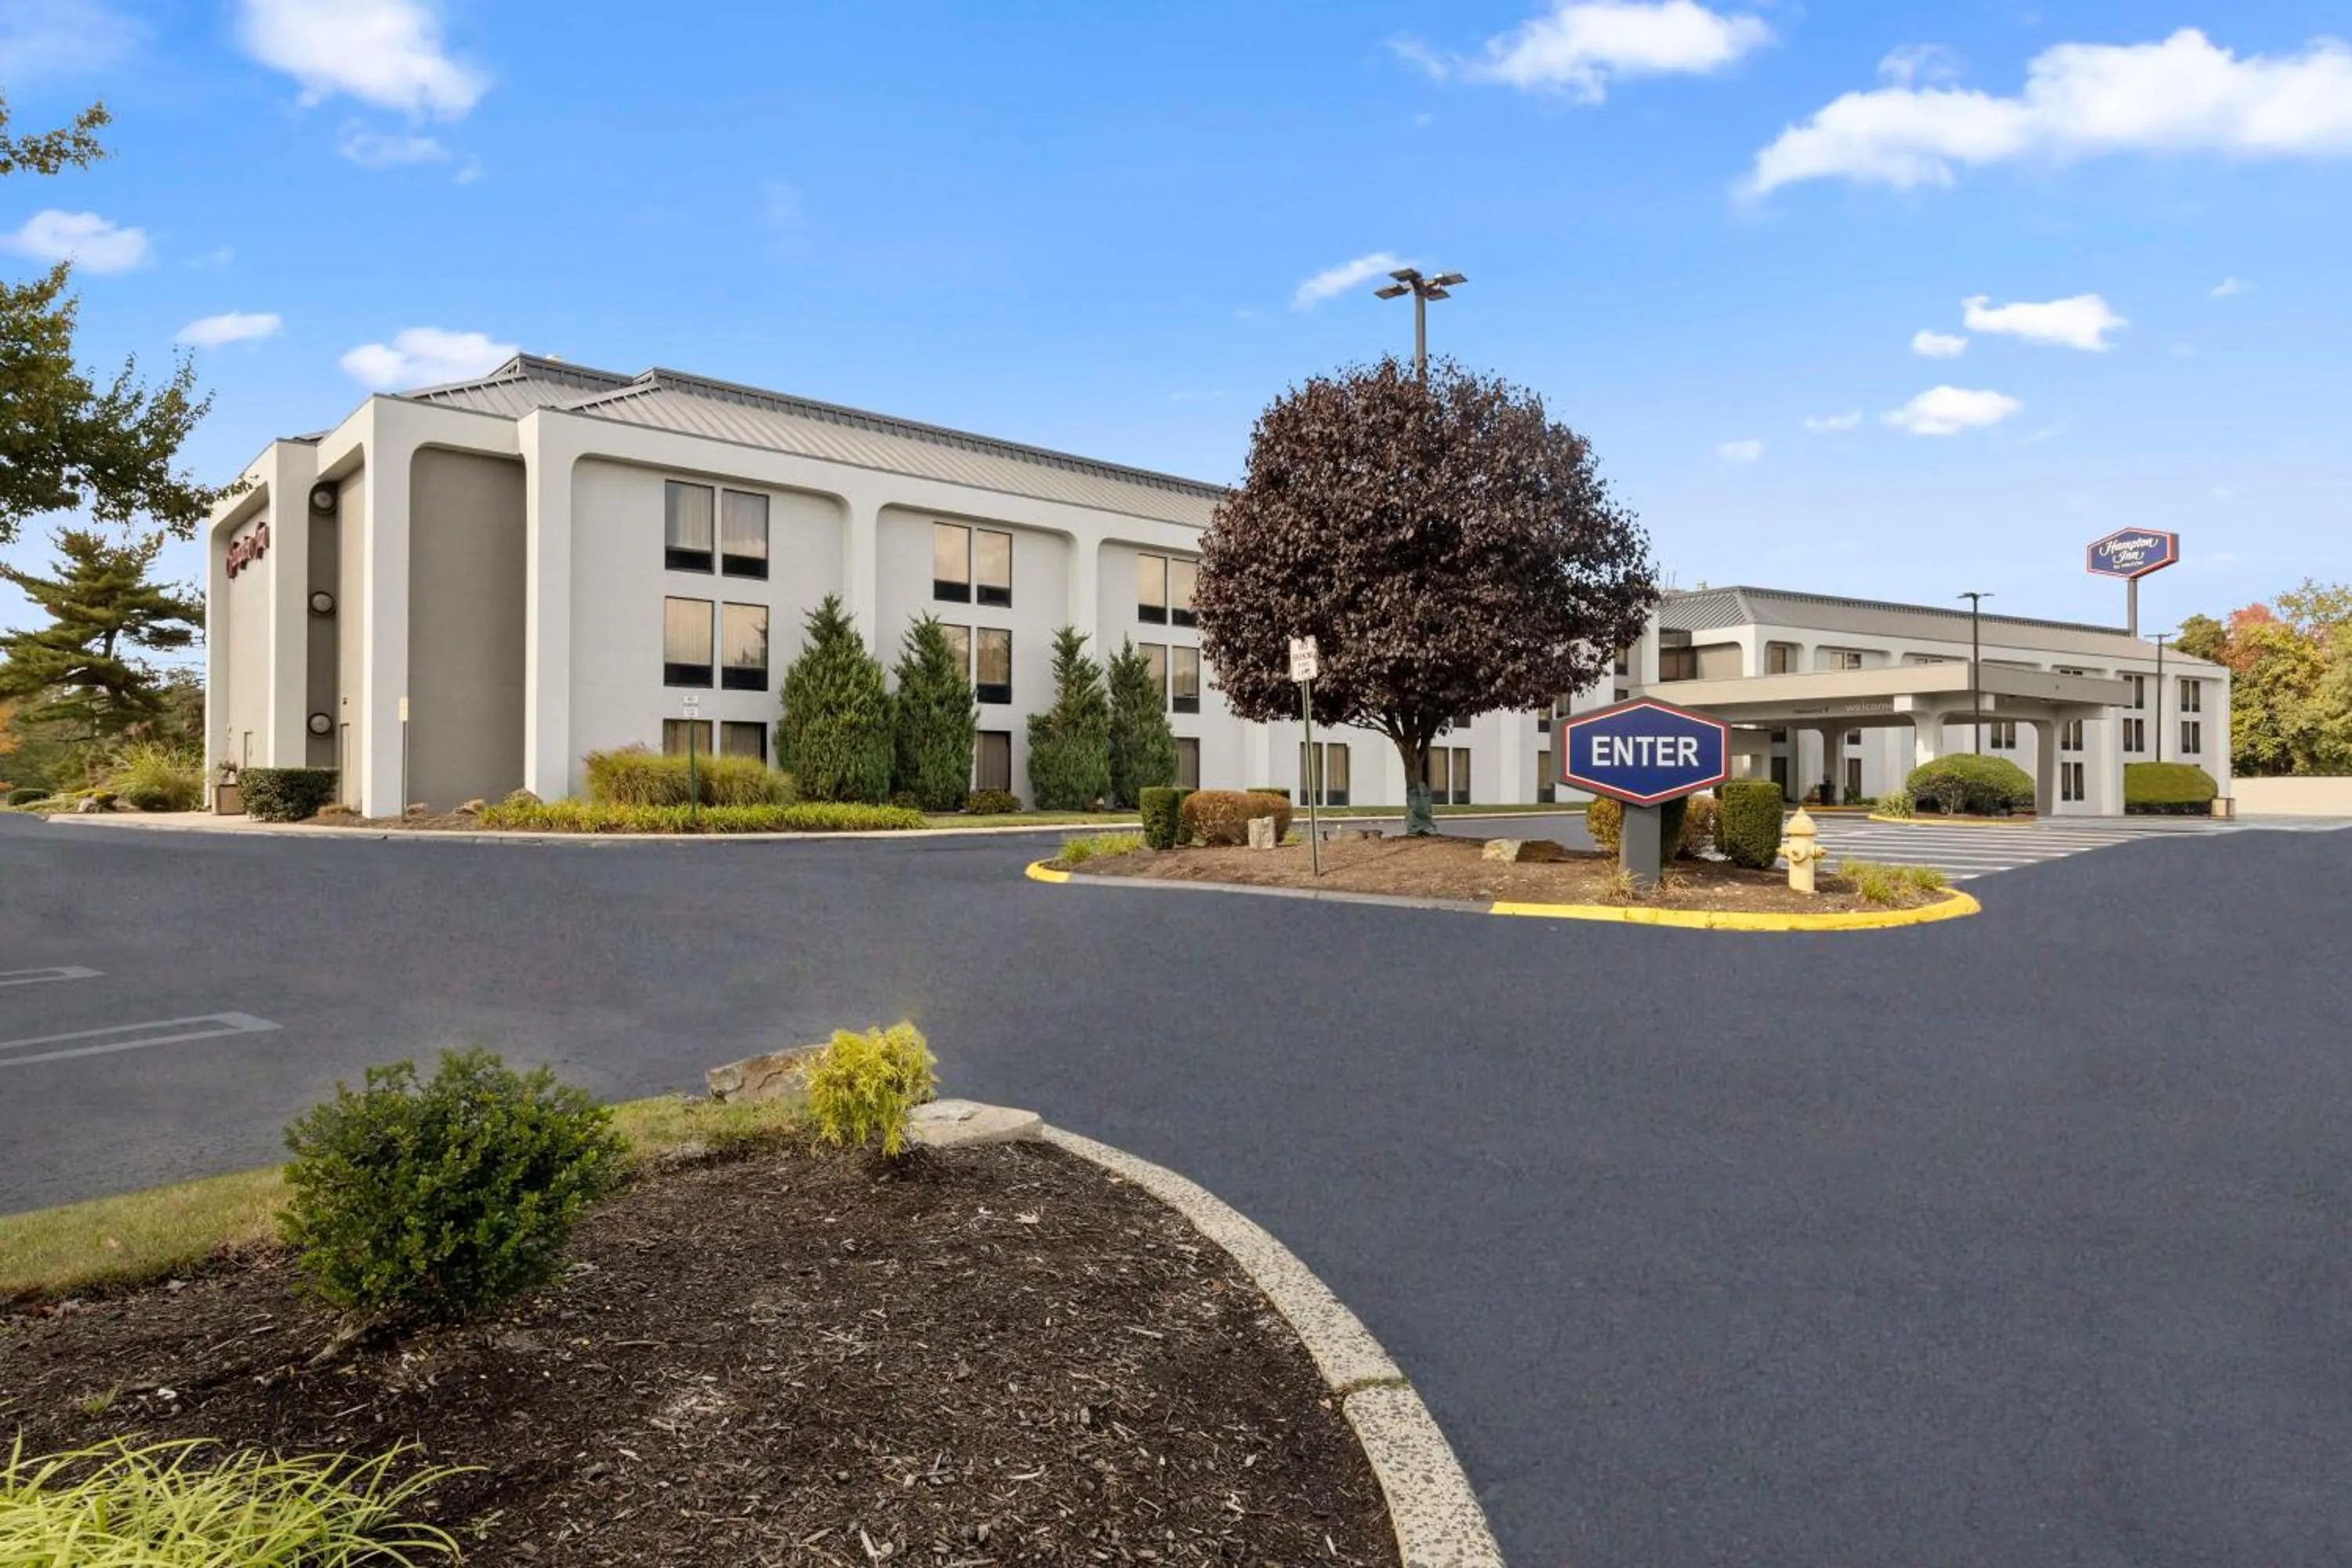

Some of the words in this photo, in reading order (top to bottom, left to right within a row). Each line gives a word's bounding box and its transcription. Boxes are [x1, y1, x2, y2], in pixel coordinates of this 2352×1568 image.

[2099, 537, 2158, 557] Hampton
[2112, 550, 2144, 563] Inn
[1592, 736, 1700, 767] ENTER
